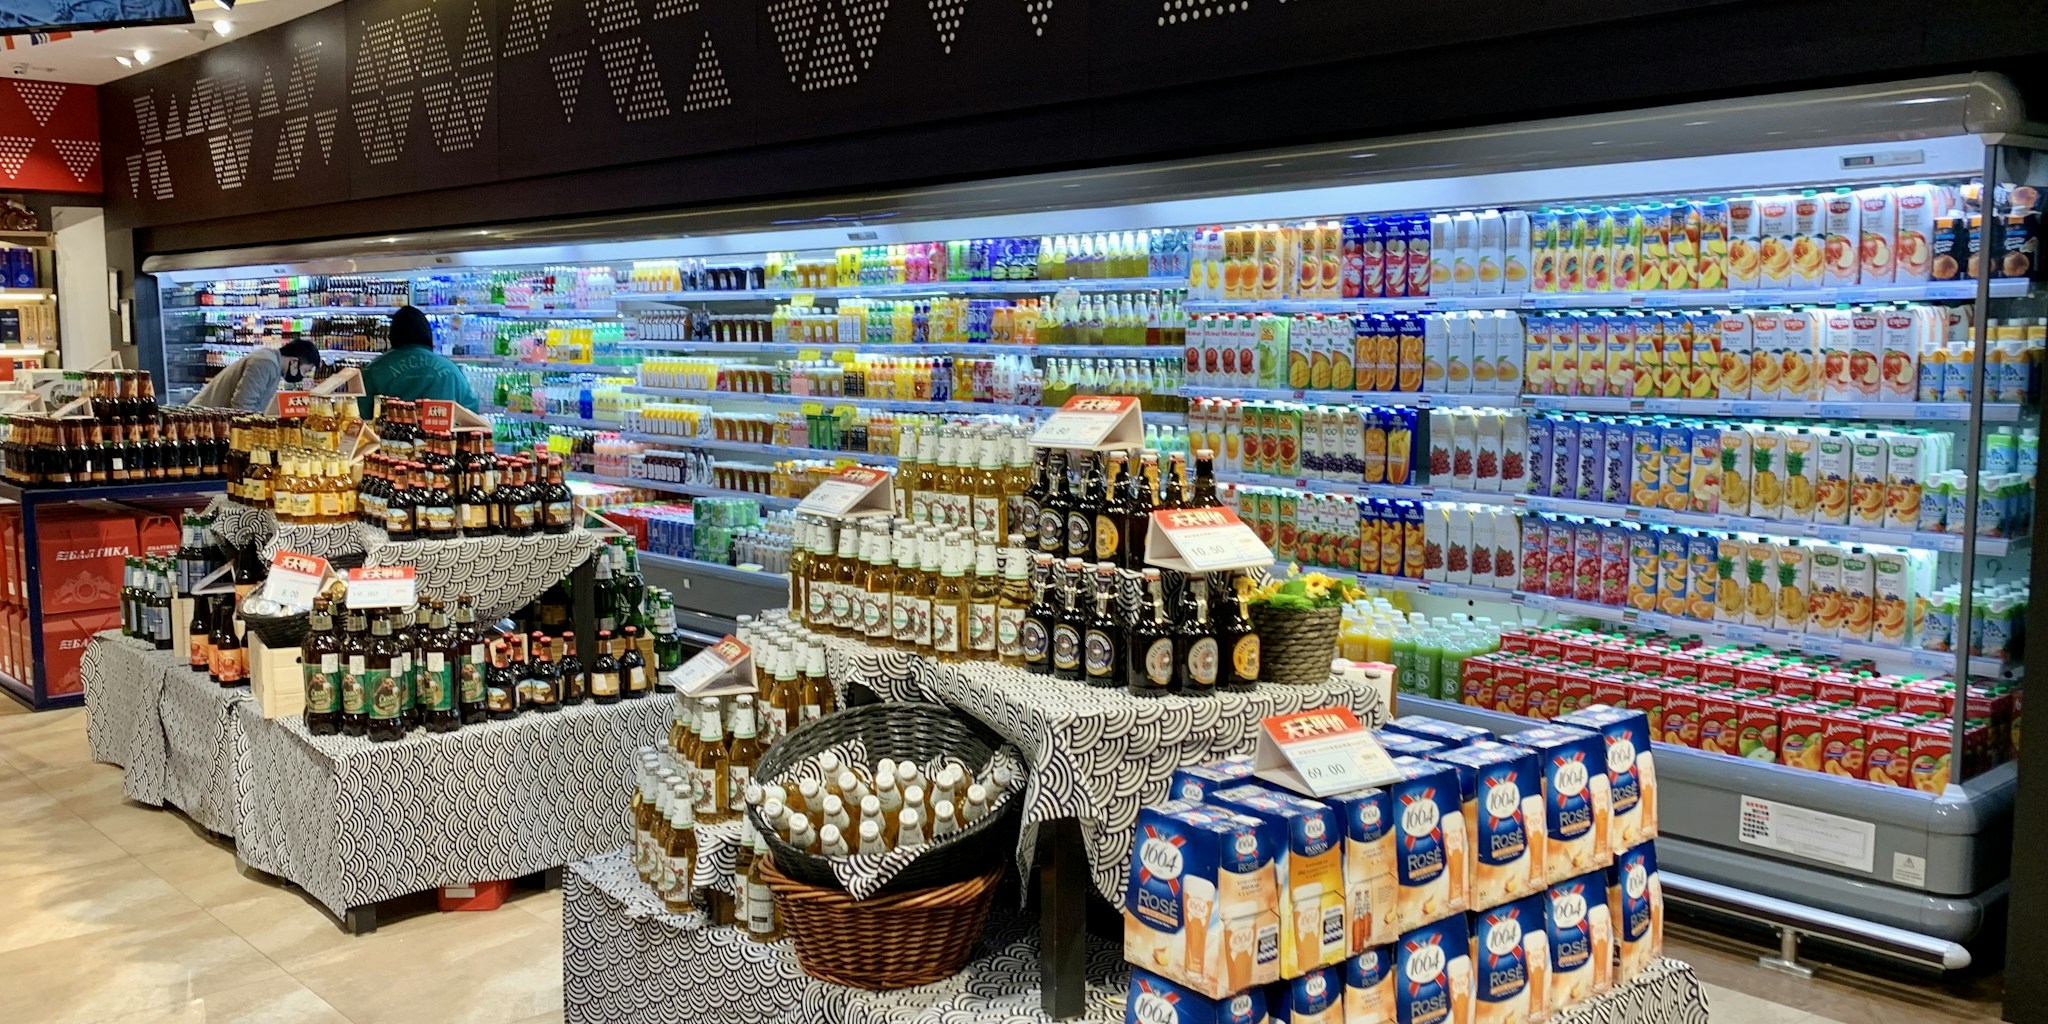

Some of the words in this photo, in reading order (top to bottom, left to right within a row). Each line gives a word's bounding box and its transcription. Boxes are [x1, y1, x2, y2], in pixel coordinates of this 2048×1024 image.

[390, 354, 450, 377] ARCHIVE
[287, 396, 310, 407] 天天平
[1168, 511, 1229, 527] 天天平价
[1191, 544, 1226, 557] 10.50
[1281, 714, 1349, 739] 天天平价
[1610, 747, 1632, 764] 1664
[1308, 763, 1346, 780] 69.00
[1558, 768, 1584, 787] 1664
[1489, 790, 1517, 810] 1664
[1405, 809, 1434, 831] 1664
[1142, 843, 1180, 872] 1664
[1137, 887, 1179, 919] ROSÉ
[1555, 900, 1584, 918] 664
[1489, 924, 1517, 948] 1664
[1410, 953, 1441, 975] 1664
[1137, 998, 1173, 1024] 1664
